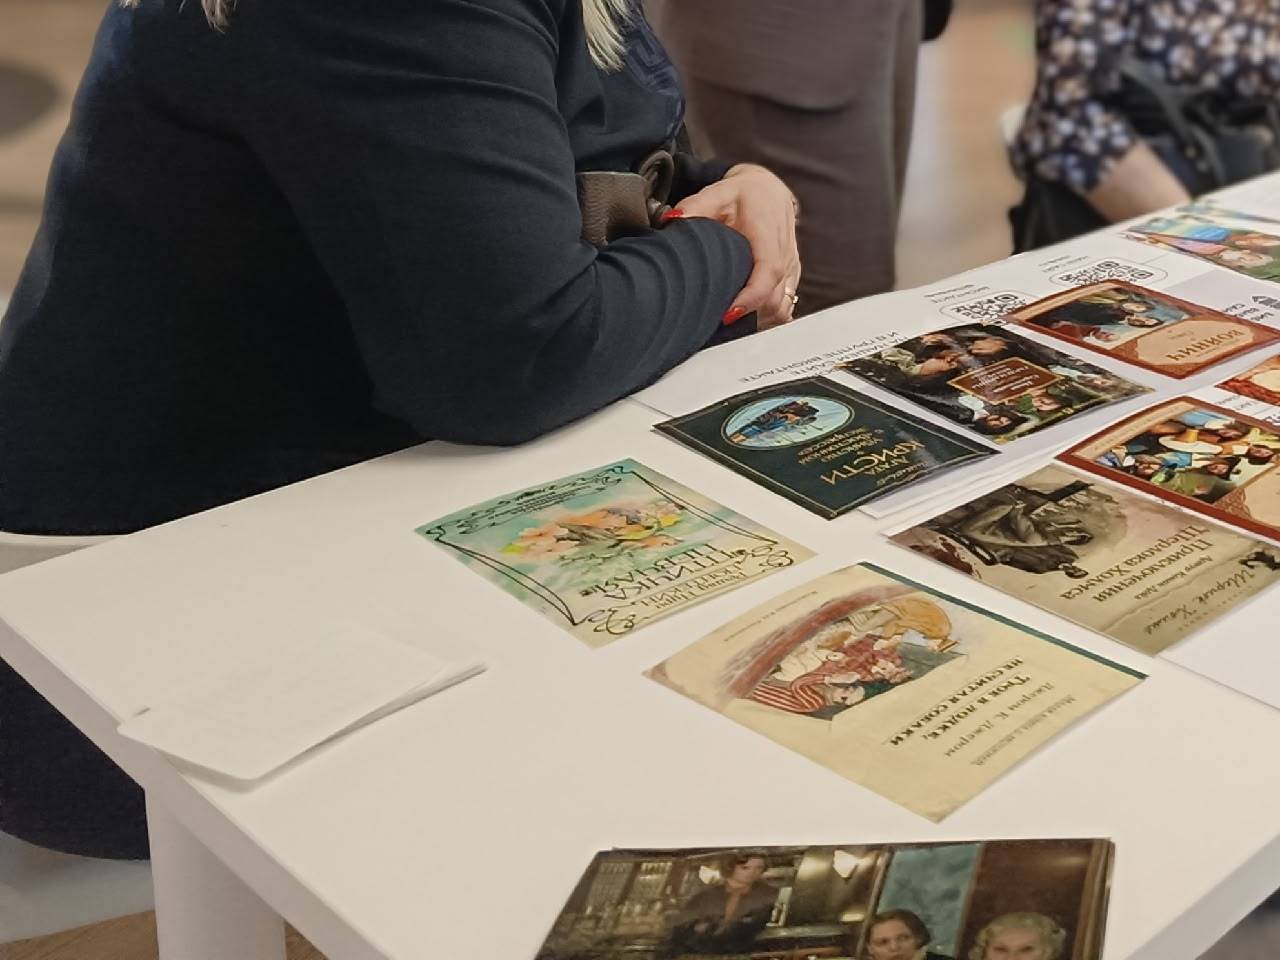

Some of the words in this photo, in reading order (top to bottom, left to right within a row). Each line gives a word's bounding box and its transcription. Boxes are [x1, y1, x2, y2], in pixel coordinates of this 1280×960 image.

[814, 438, 928, 486] КРИСТИ
[591, 542, 719, 593] ПЕВЧАЯ
[1118, 524, 1204, 569] Шерлока
[602, 549, 735, 604] ПТИЧКА
[1057, 563, 1131, 603] Холмса
[1089, 536, 1214, 604] Приключения
[1005, 680, 1056, 712] Джером
[940, 719, 997, 758] Джером
